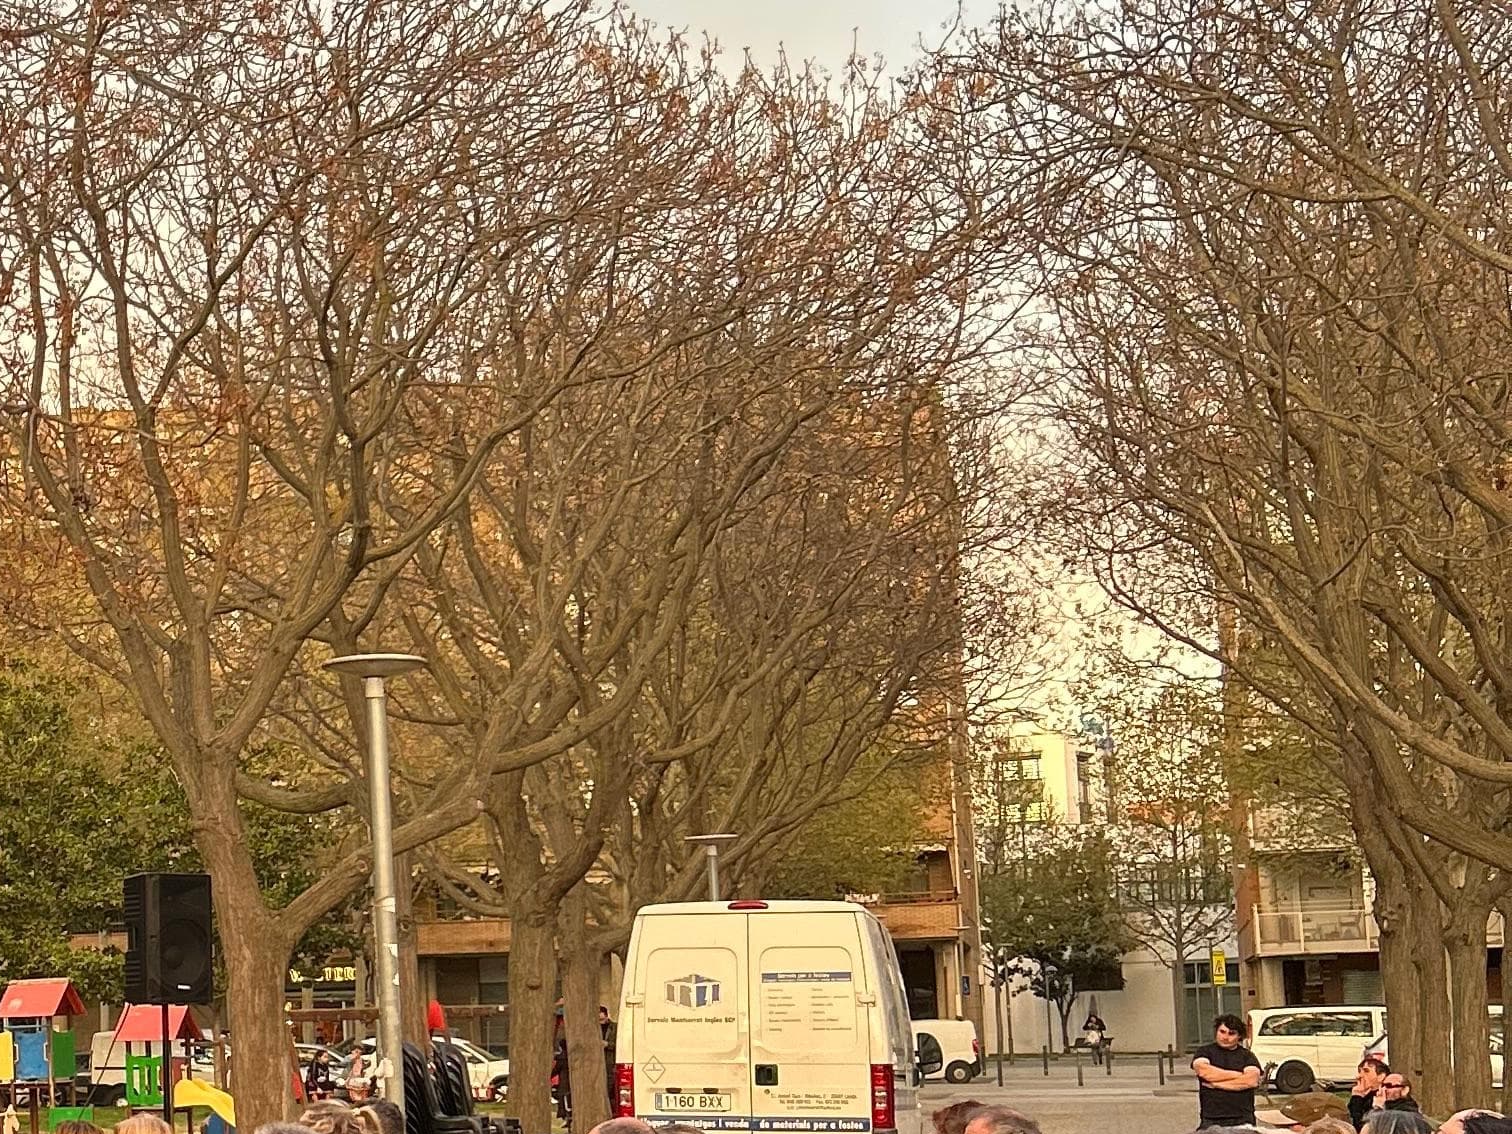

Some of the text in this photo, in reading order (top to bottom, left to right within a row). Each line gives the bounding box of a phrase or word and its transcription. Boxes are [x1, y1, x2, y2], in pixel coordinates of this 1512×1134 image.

[665, 1095, 723, 1108] 1160 BXX
[724, 1118, 750, 1128] venda
[759, 1119, 770, 1129] de
[772, 1119, 811, 1129] materials
[813, 1120, 828, 1131] per
